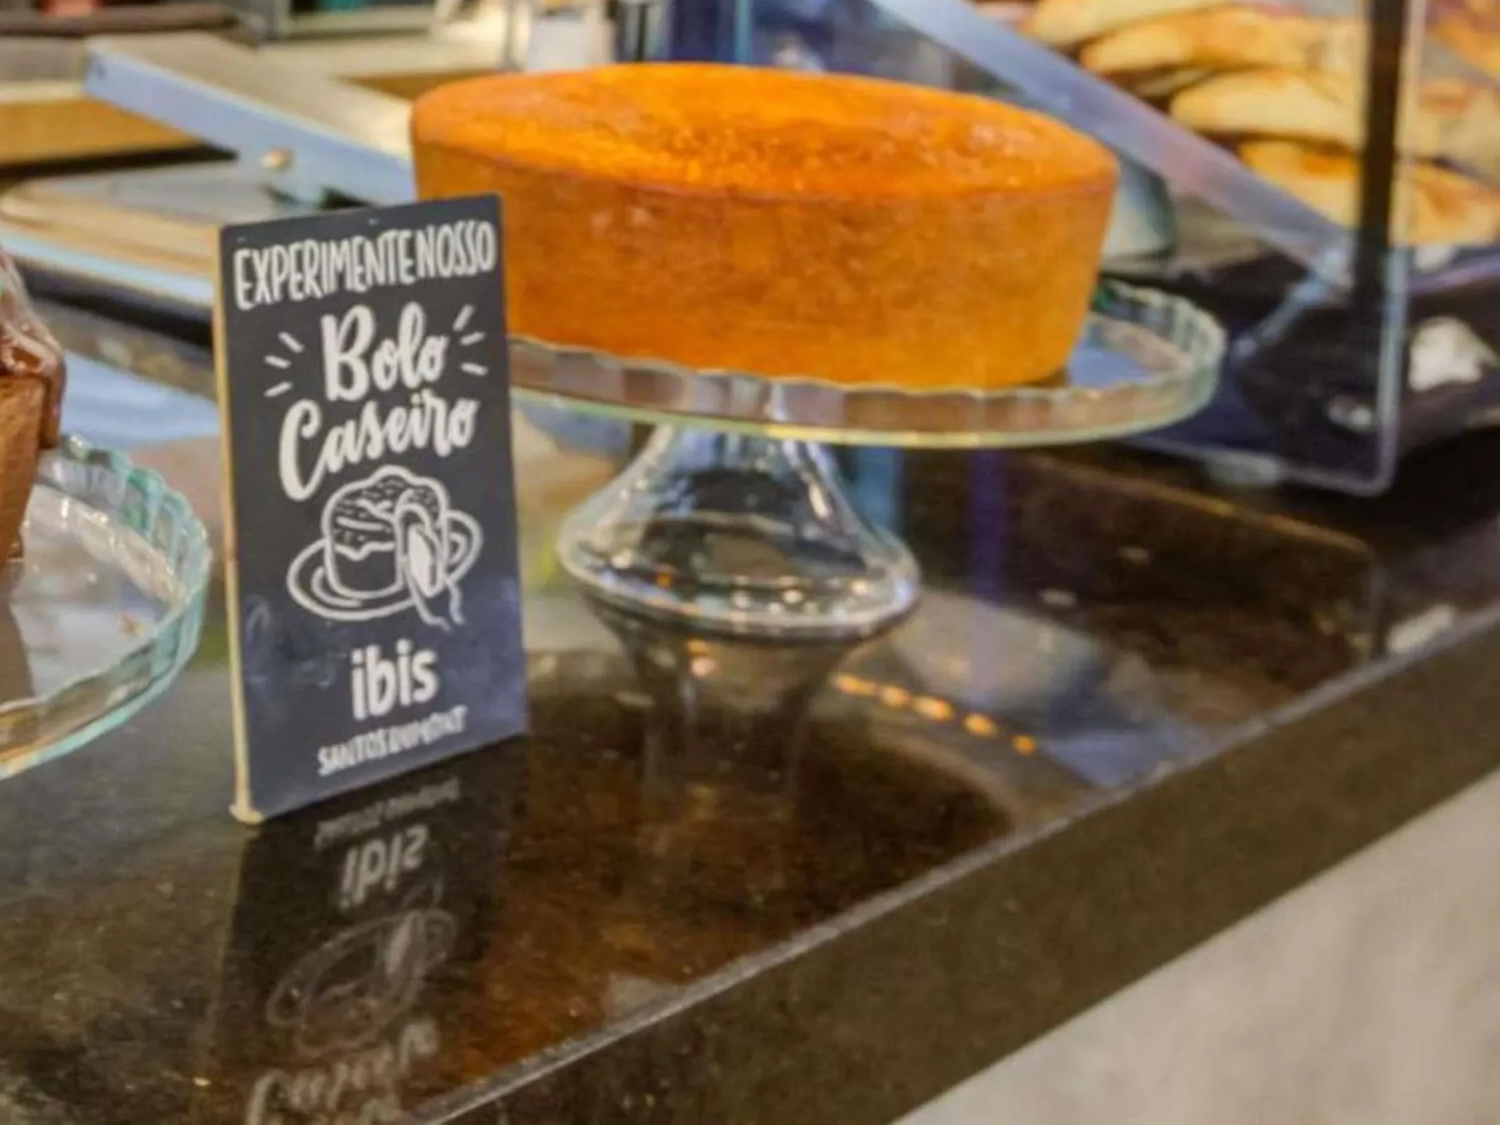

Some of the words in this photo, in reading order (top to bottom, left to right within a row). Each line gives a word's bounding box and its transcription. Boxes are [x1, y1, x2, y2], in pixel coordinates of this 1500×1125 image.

[233, 229, 416, 310] EXPERIMENTE
[415, 220, 495, 279] NOSSO
[321, 302, 449, 402] Bolo
[279, 388, 481, 502] Caseiro
[352, 638, 438, 720] ibis
[317, 728, 387, 777] SANTOS
